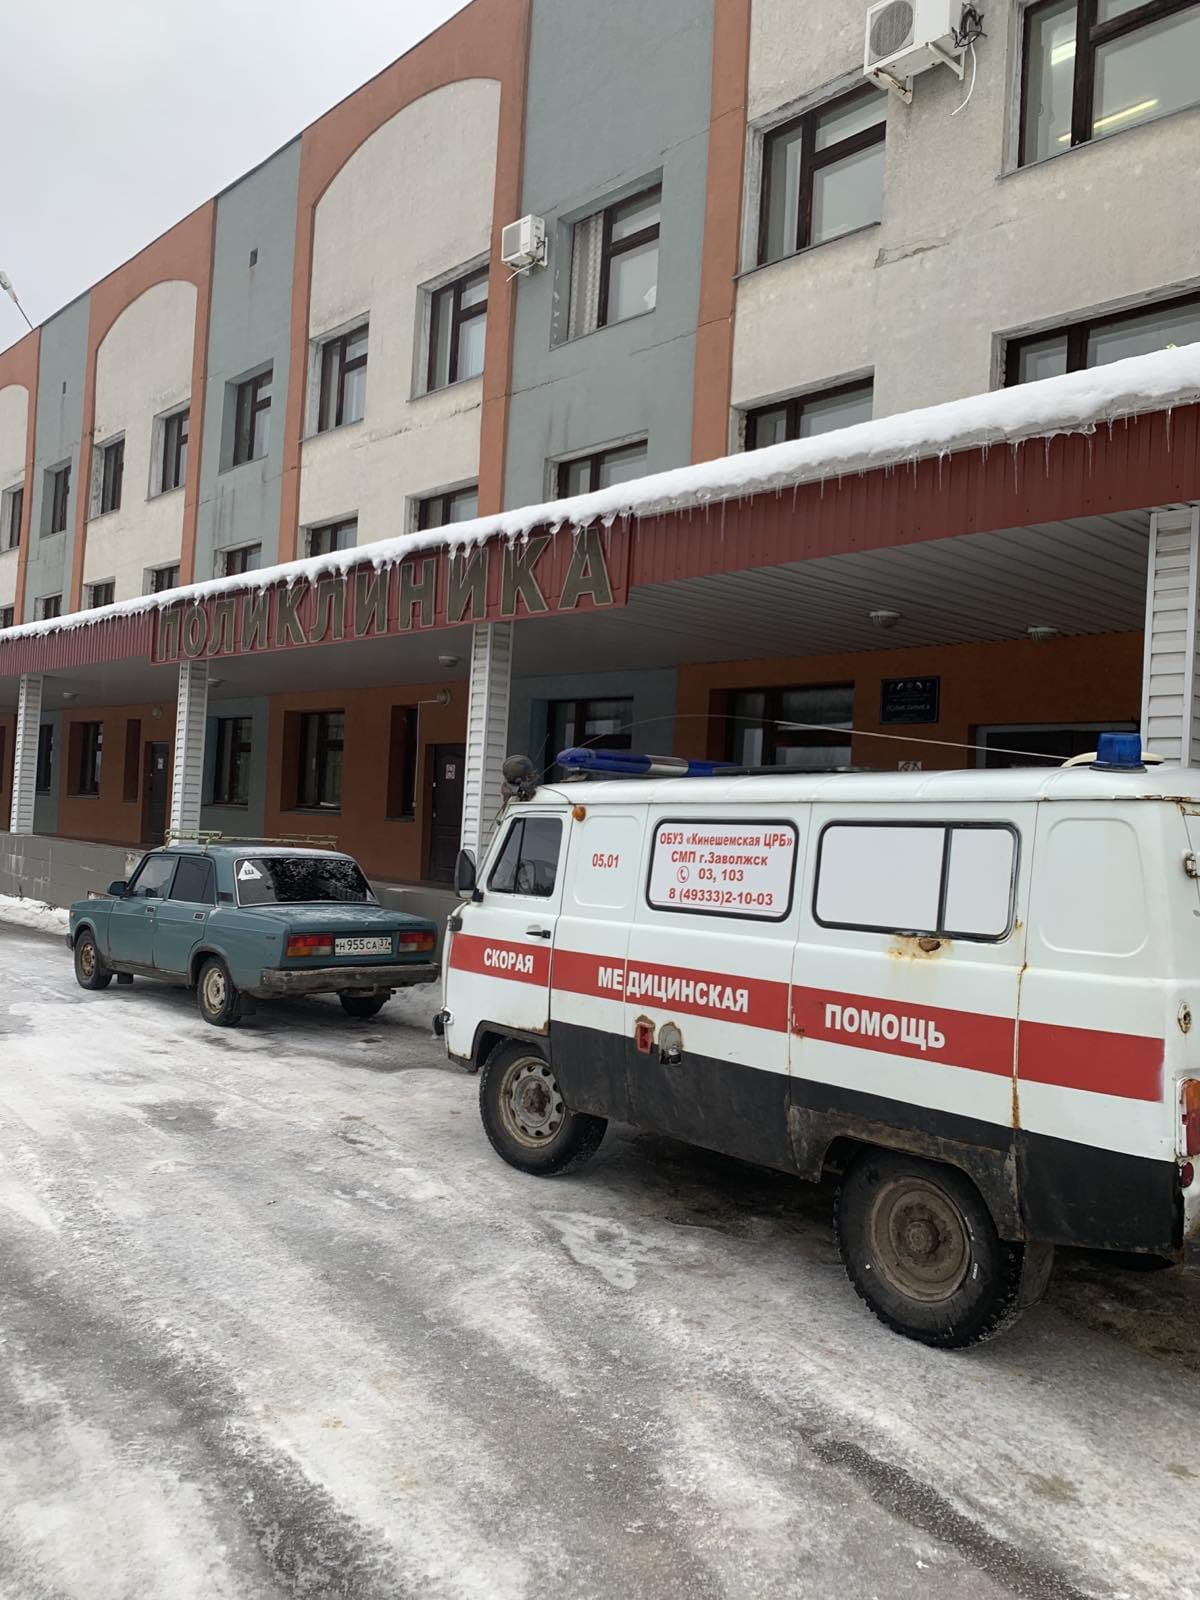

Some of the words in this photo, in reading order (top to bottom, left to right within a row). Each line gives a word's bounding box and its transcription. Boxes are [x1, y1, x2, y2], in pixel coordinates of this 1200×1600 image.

[157, 527, 614, 662] ПОЛИКЛИНИКА
[659, 832, 684, 845] ОБУЗ
[686, 833, 761, 847] «Кинешемская
[763, 833, 793, 849] ЦРБ»
[671, 850, 696, 863] СМП
[698, 852, 769, 866] г.Заволжск
[698, 868, 717, 883] 03,
[721, 869, 744, 882] 103
[668, 887, 676, 899] 8
[679, 888, 774, 906] (49333)2-10-03
[483, 947, 534, 975] СКОРАЯ
[597, 966, 749, 1014] МЕДИЦИНСКАЯ
[824, 1003, 946, 1051] ПОМОЩЬ
